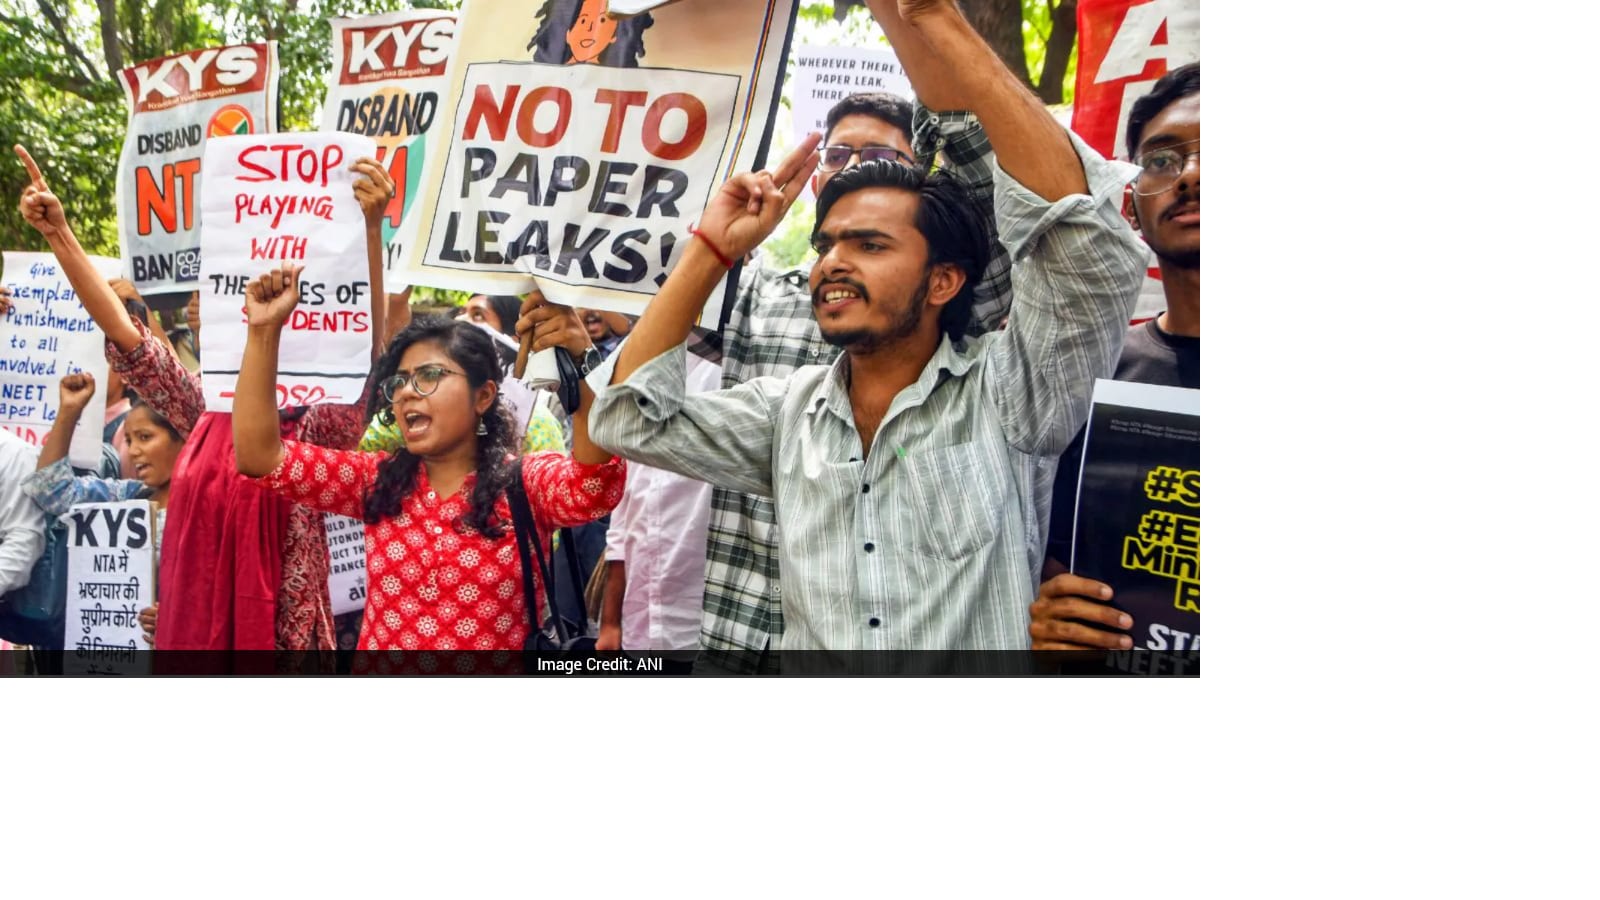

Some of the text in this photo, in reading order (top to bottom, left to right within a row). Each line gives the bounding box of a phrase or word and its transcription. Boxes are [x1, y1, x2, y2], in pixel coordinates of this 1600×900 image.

[349, 18, 456, 75] KYS
[135, 46, 258, 103] KYS
[798, 57, 857, 69] WHEREVER
[861, 60, 895, 74] THERE
[812, 89, 843, 101] THERE
[816, 74, 886, 89] PAPER LEAK,
[337, 91, 439, 137] DISBAND
[462, 84, 707, 161] NO TO
[138, 124, 202, 156] DISBAND
[235, 144, 344, 187] STOP
[135, 158, 201, 236] NT
[460, 147, 689, 218] PAPER
[235, 193, 334, 229] PLAYING
[251, 235, 308, 260] WITH
[439, 210, 677, 288] LEAKS!
[30, 262, 56, 281] Give
[133, 253, 173, 282] BAN
[209, 274, 249, 296] THE
[336, 281, 368, 305] OF
[6, 304, 95, 332] Punishment
[11, 335, 58, 351] to all
[0, 356, 56, 376] nvolved
[2, 384, 47, 401] NEET
[43, 402, 57, 420] le
[71, 508, 148, 549] KYS
[348, 518, 365, 528] HA
[93, 549, 128, 573] NTA में
[330, 548, 349, 560] UCT
[1121, 535, 1200, 584] Min
[78, 576, 140, 601] भ्रष्टाचार की
[80, 602, 138, 634] सुप्रीम कोर्ट
